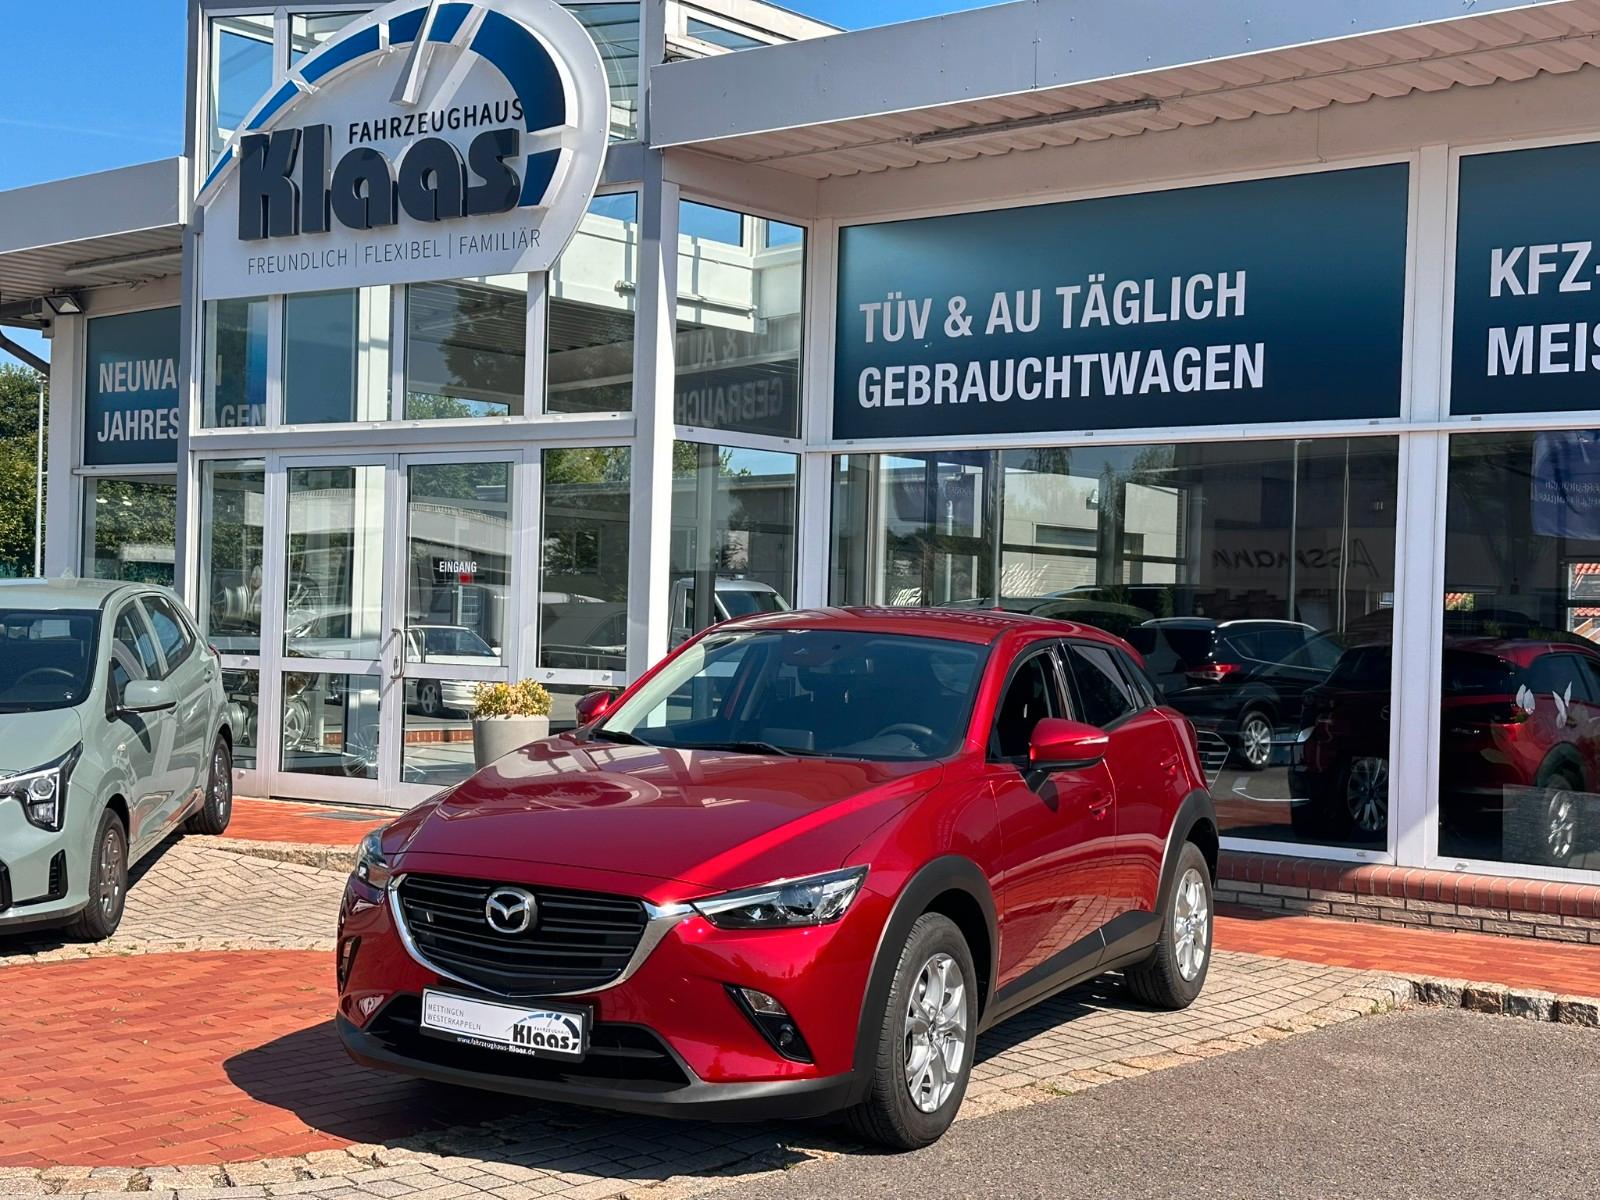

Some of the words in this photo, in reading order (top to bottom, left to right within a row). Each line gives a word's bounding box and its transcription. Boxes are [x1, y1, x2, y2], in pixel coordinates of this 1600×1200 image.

[348, 98, 524, 144] FAHRZEUGHAUS
[238, 123, 520, 241] Klaas
[248, 247, 348, 275] FREUNDLICH
[364, 239, 441, 263] FLEXIBEL
[459, 228, 541, 255] FAMILIÄR
[859, 291, 932, 343] TÜV
[943, 296, 973, 338] &
[985, 289, 1041, 335] AU
[1056, 270, 1246, 329] TÄGLICH
[98, 358, 180, 393] NEUWA
[858, 343, 1265, 408] GEBRAUCHTWAGEN
[439, 561, 477, 573] EINGANG
[512, 1023, 571, 1050] Klaas
